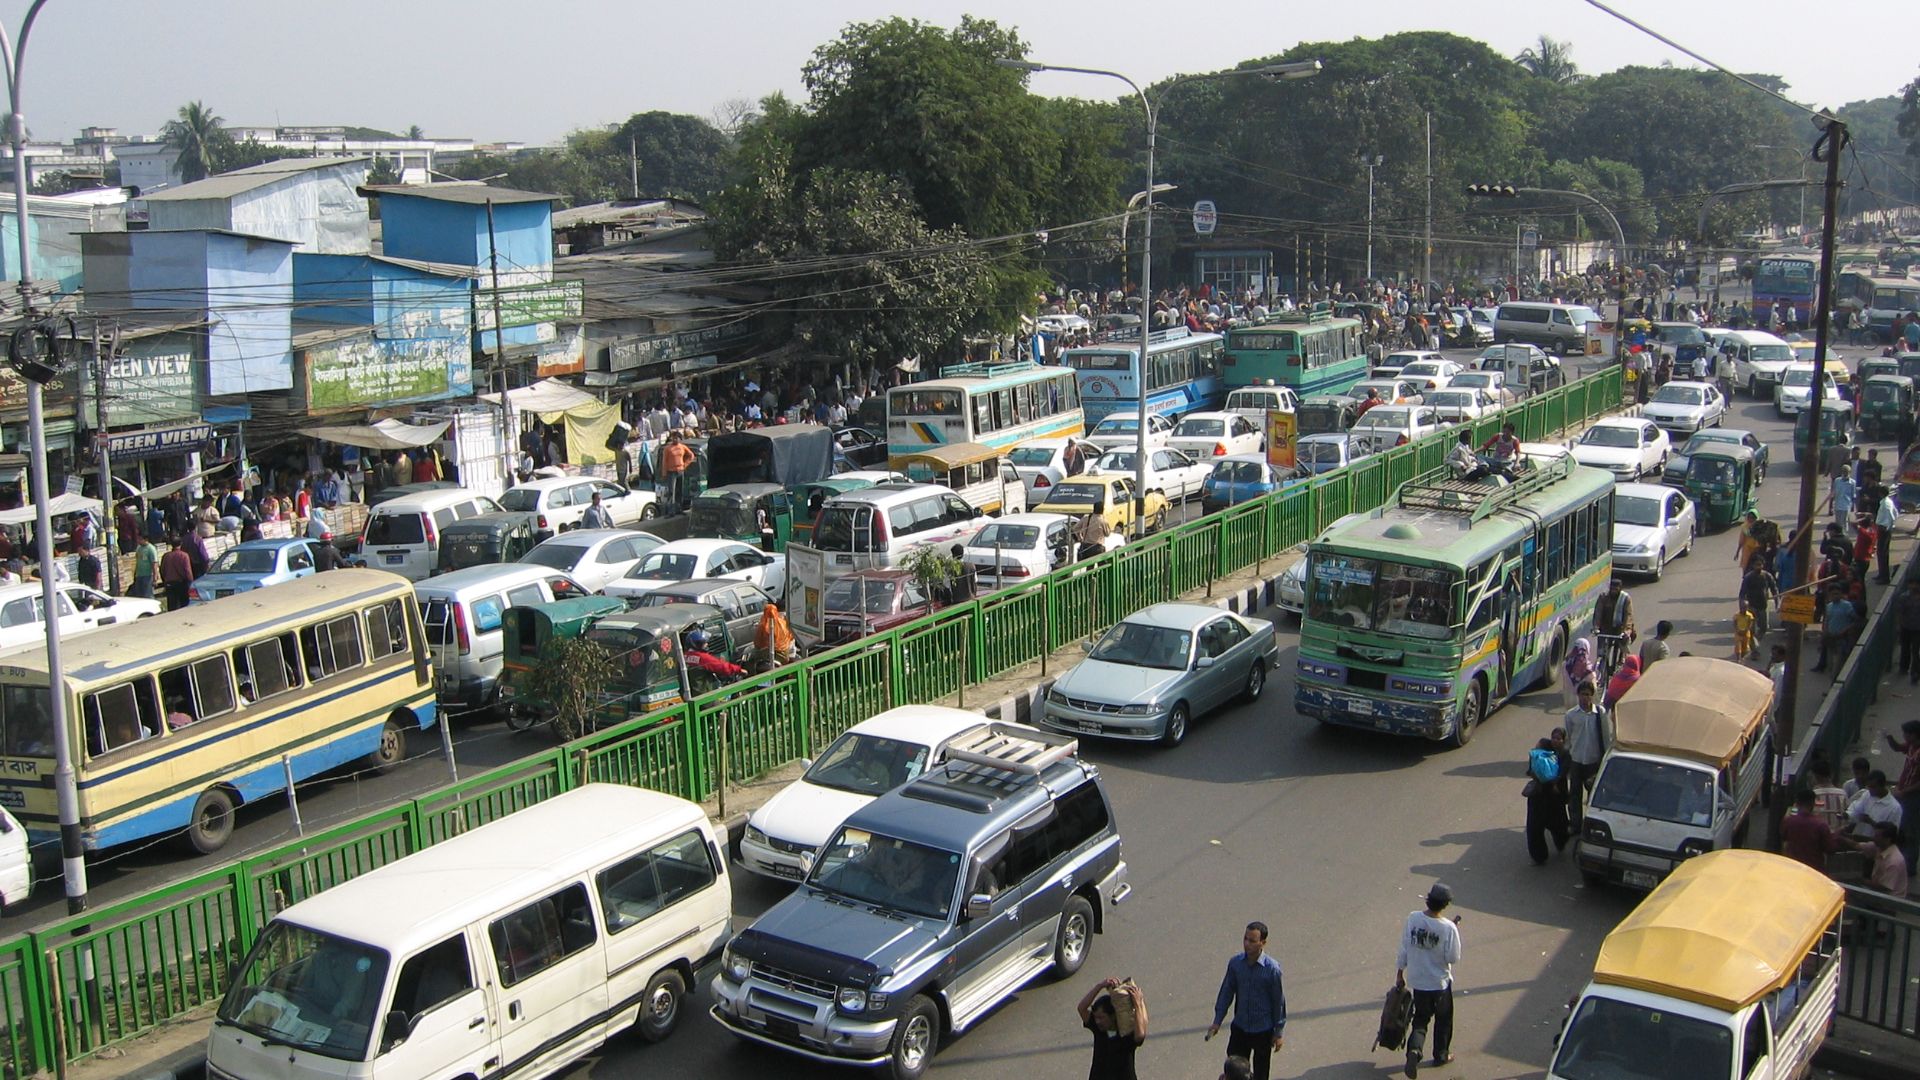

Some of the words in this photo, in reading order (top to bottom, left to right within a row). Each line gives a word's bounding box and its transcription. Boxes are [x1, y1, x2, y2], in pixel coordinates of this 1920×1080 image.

[1762, 260, 1809, 268] Falgun
[147, 353, 192, 376] VIEW
[161, 427, 209, 444] VIEW
[10, 669, 26, 678] BUS
[9, 760, 37, 776] বাস
